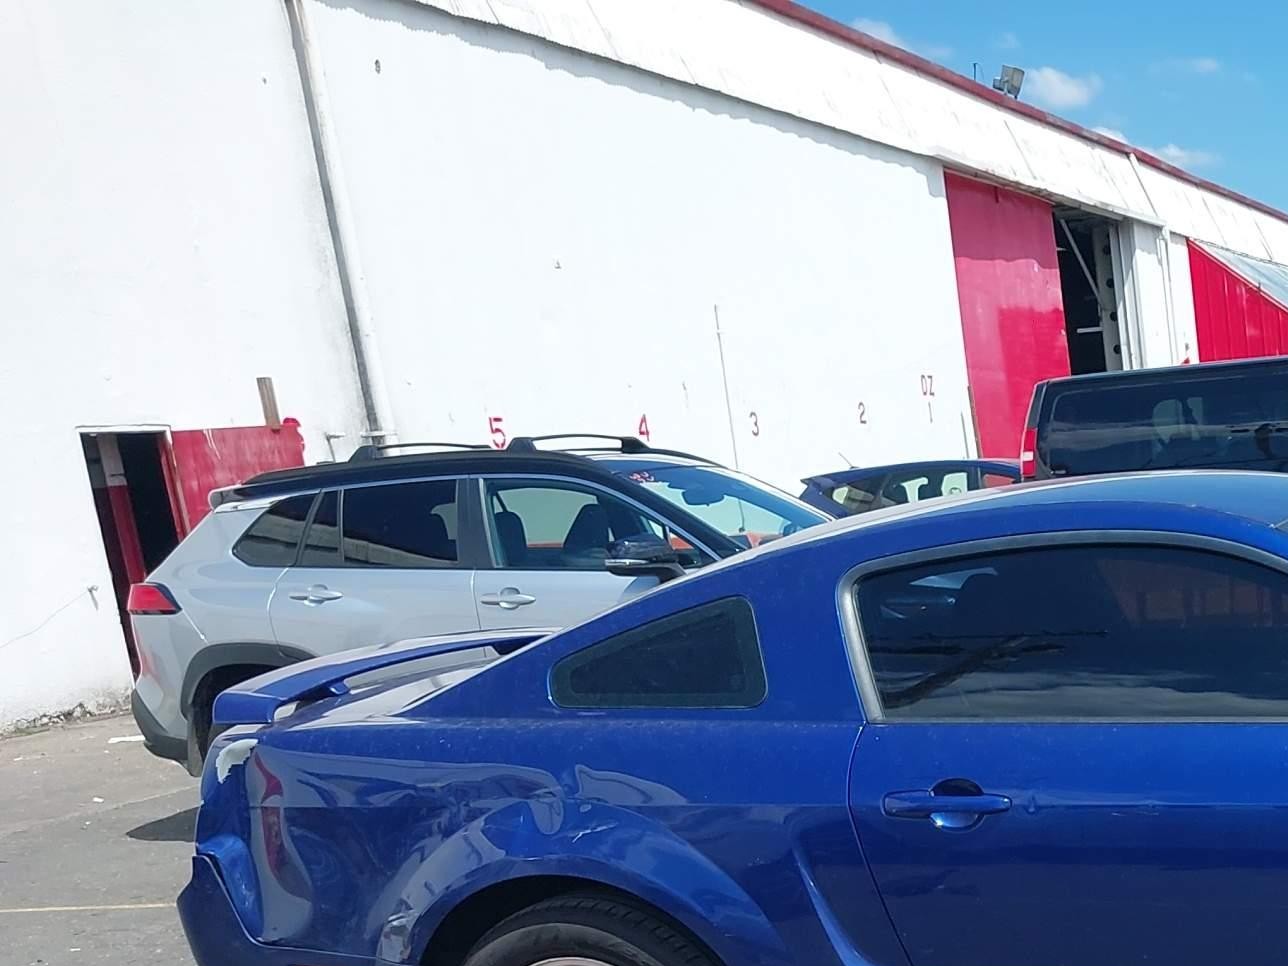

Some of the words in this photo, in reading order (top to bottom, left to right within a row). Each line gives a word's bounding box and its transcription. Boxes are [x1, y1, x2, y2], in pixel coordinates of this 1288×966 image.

[749, 411, 760, 437] 3
[857, 402, 867, 424] 2
[488, 416, 506, 449] 5
[638, 413, 650, 442] 4
